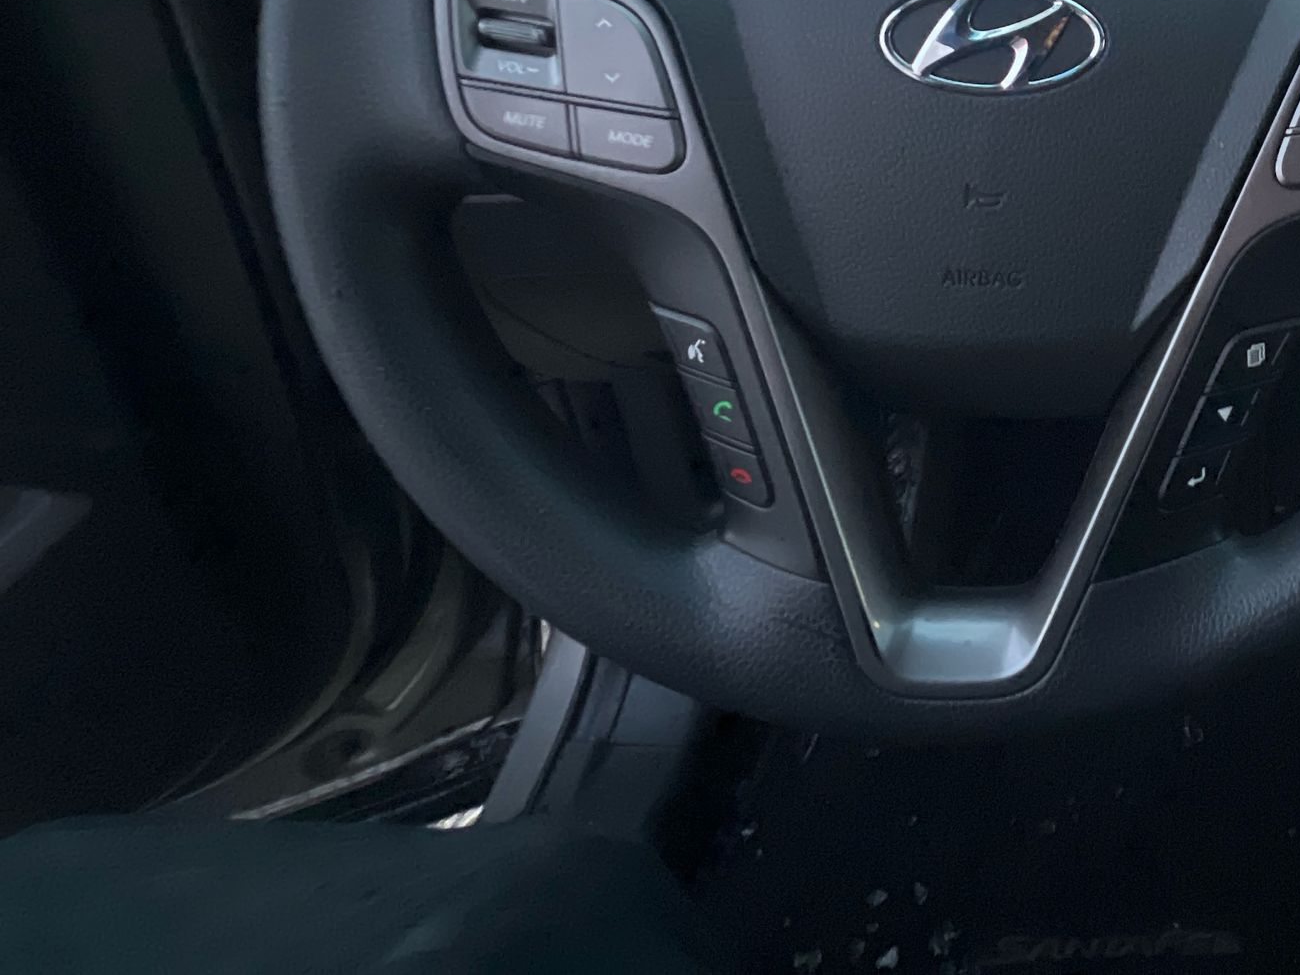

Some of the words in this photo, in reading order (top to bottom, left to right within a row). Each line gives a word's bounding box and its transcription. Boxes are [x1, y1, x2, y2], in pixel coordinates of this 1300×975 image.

[503, 111, 546, 130] MUTE
[608, 129, 655, 150] MODE
[942, 269, 1023, 288] AIRBAG
